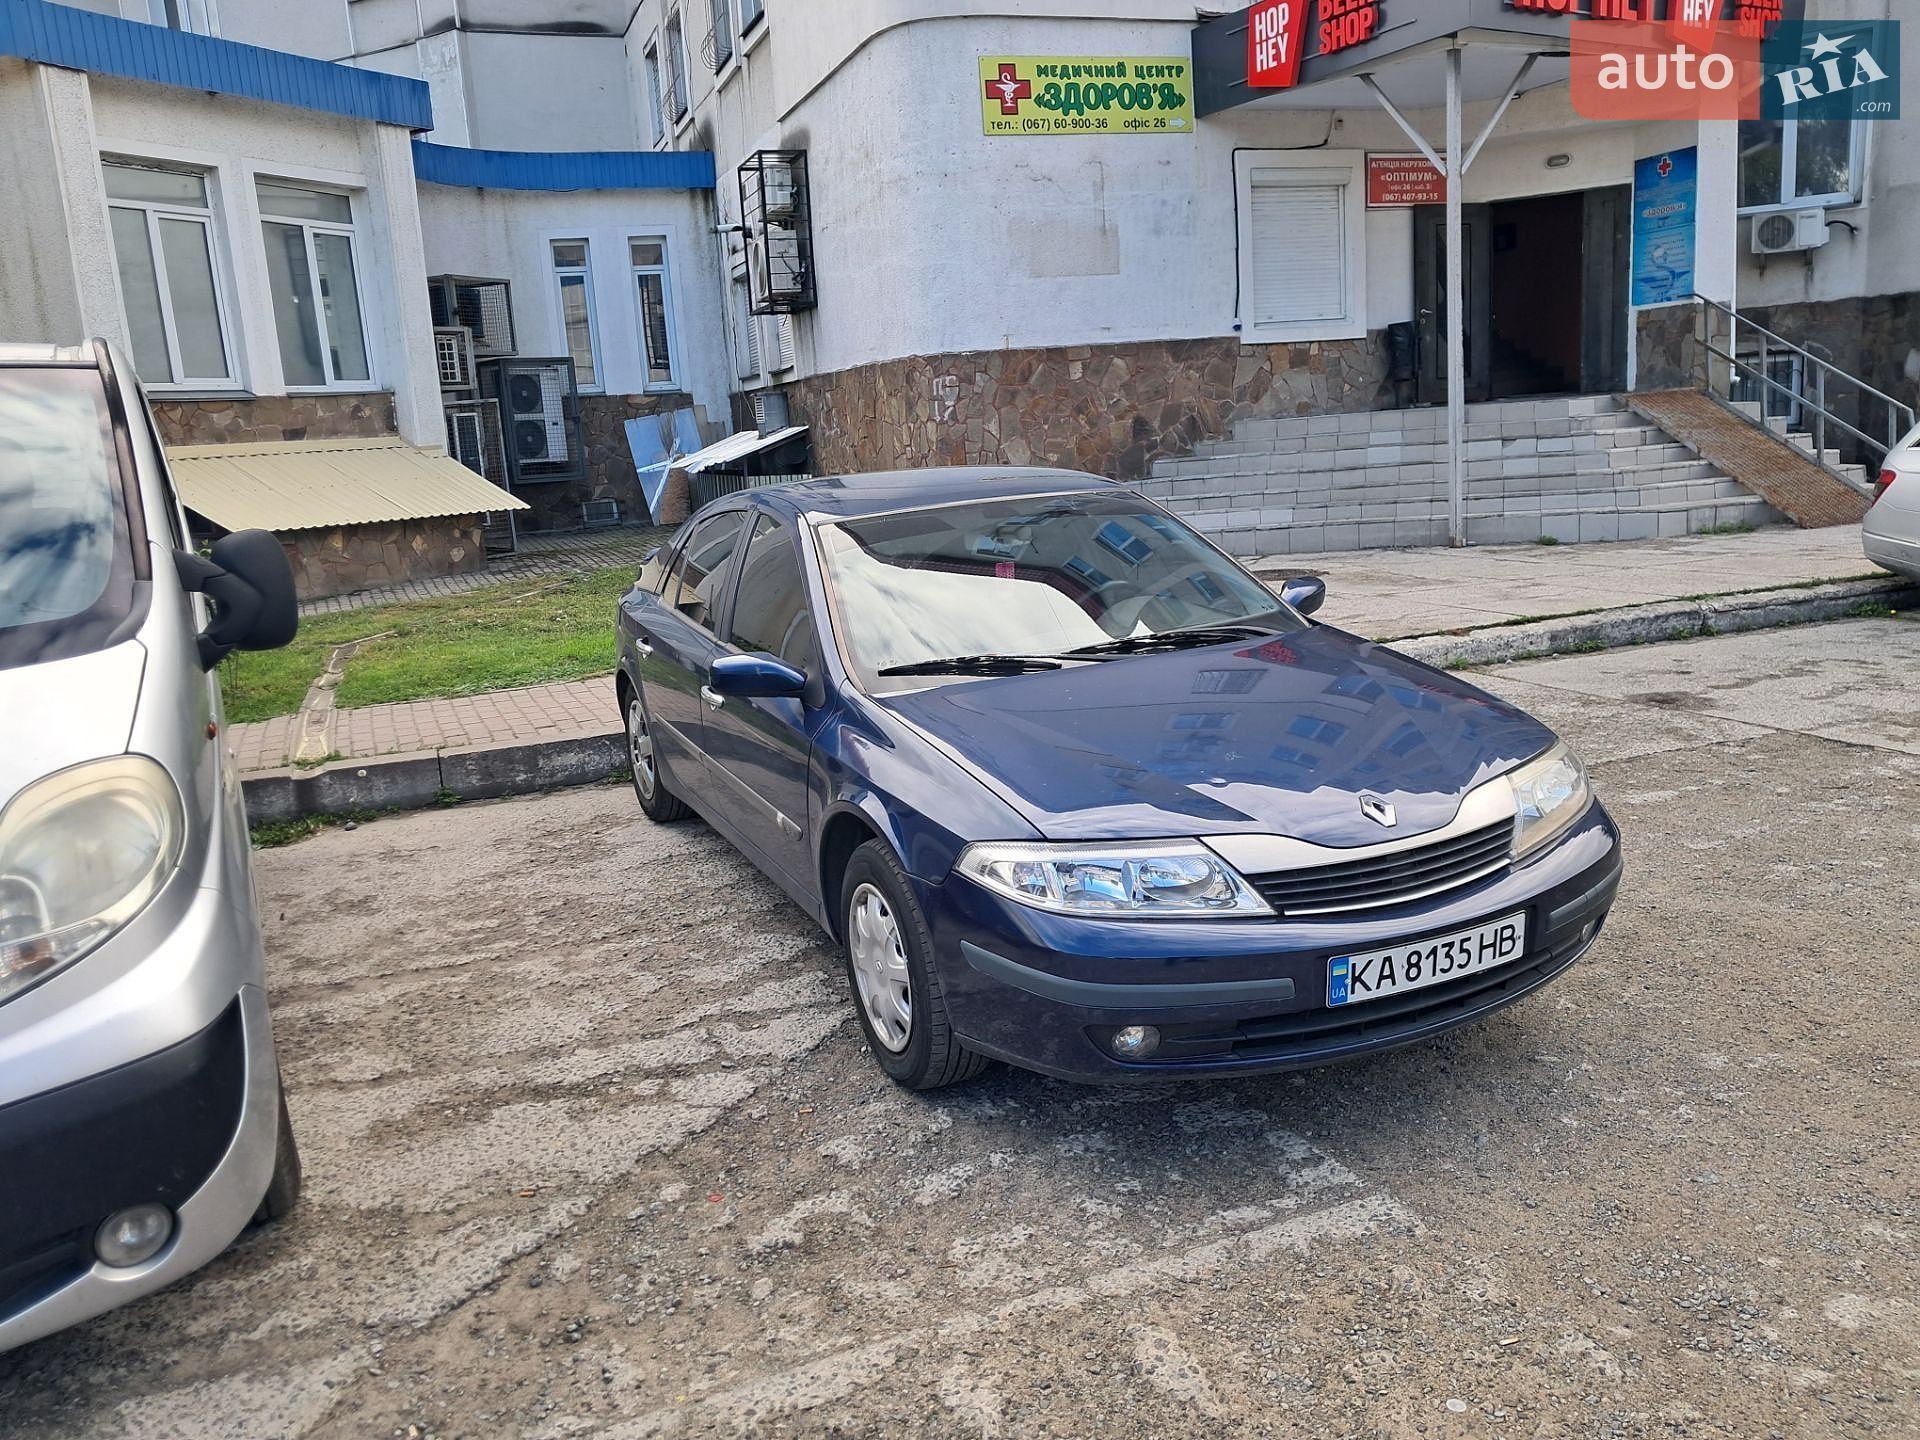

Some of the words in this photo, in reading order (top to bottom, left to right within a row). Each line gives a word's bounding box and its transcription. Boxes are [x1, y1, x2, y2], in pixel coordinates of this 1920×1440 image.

[1255, 3, 1289, 43] HOP
[1683, 0, 1714, 29] HEY
[1320, 7, 1375, 55] SHOP
[1256, 32, 1289, 73] HEY
[1036, 61, 1127, 80] МЕДИЧНИЙ
[1134, 64, 1185, 80] ЦЕНТР
[990, 121, 1018, 130] тел.:
[1022, 118, 1051, 132] (067)
[1053, 118, 1108, 129] 60-900-36
[1123, 118, 1150, 130] офіс
[1153, 118, 1167, 128] 26
[1382, 193, 1401, 202] (067)
[1402, 192, 1439, 201] 407-93-15
[1350, 955, 1397, 995] KA
[1405, 936, 1472, 983] 8135
[1478, 924, 1517, 965] HB
[1331, 987, 1346, 999] UA
